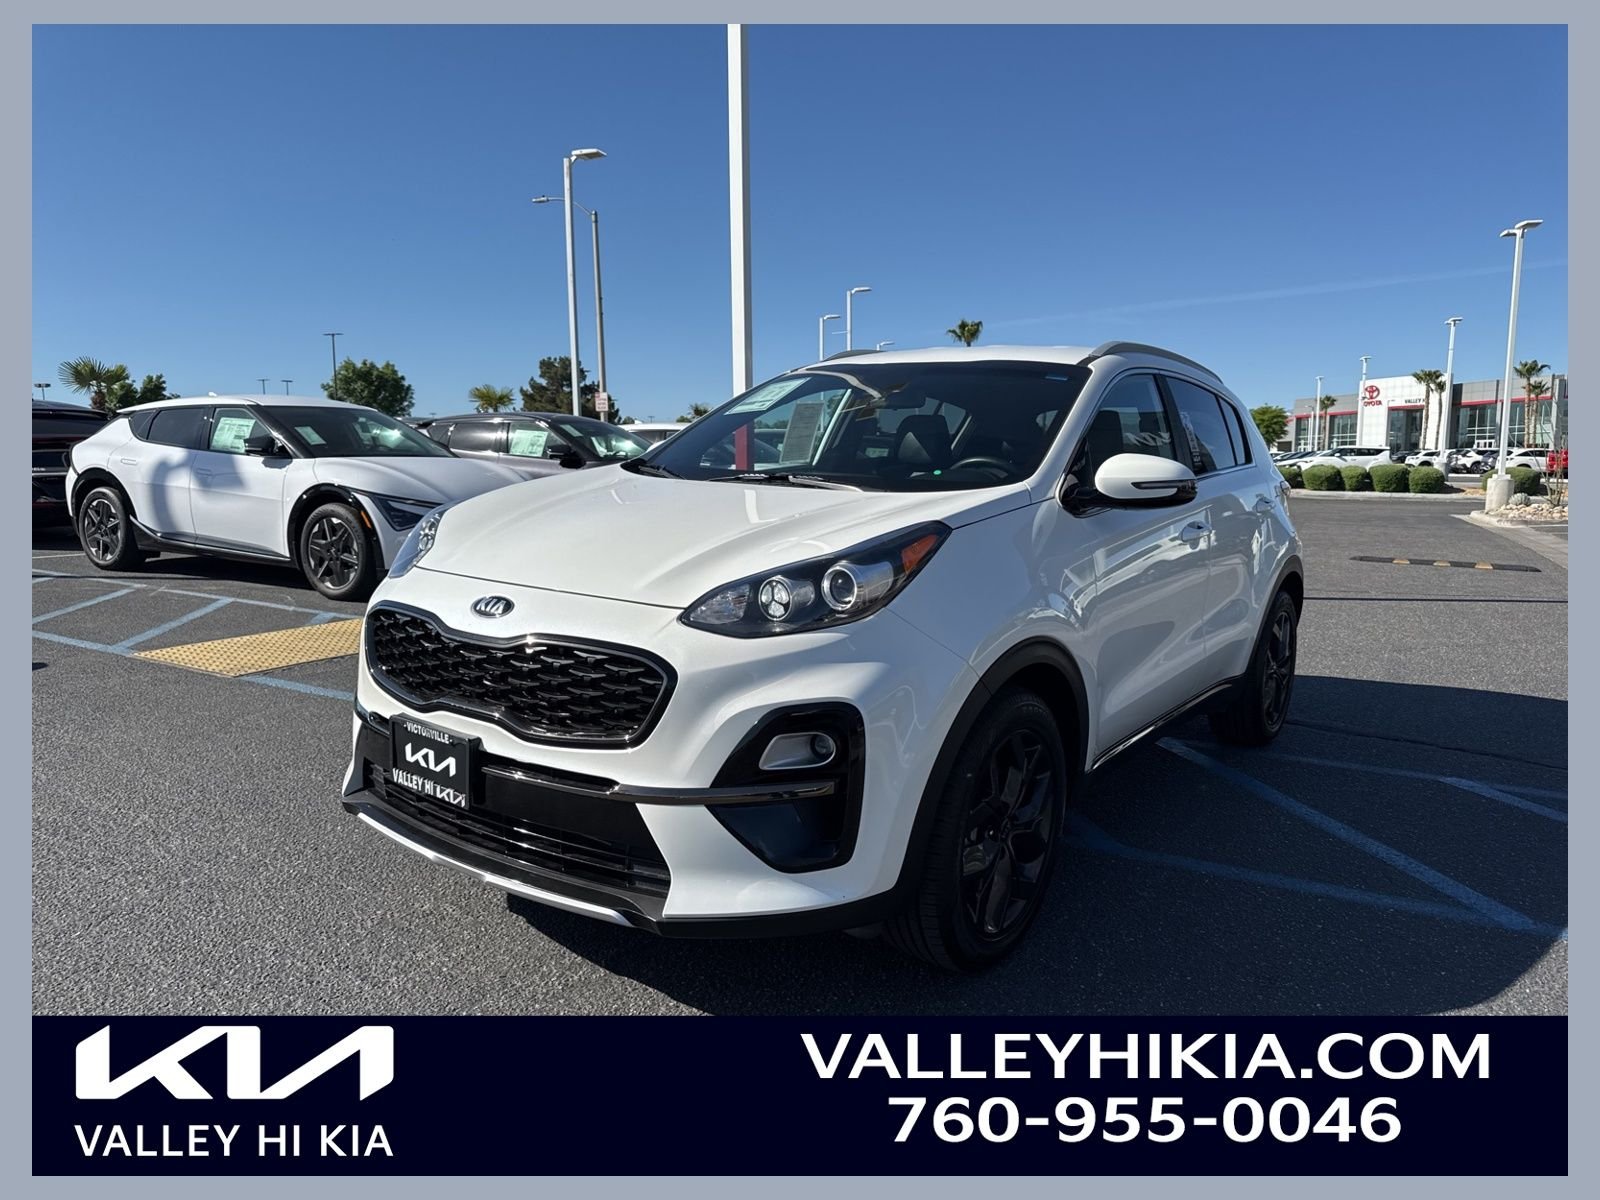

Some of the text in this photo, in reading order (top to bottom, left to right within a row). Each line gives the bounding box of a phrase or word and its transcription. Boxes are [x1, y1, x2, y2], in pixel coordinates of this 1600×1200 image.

[404, 742, 457, 778] KIA
[392, 767, 424, 791] VALLEY
[424, 779, 434, 796] HI
